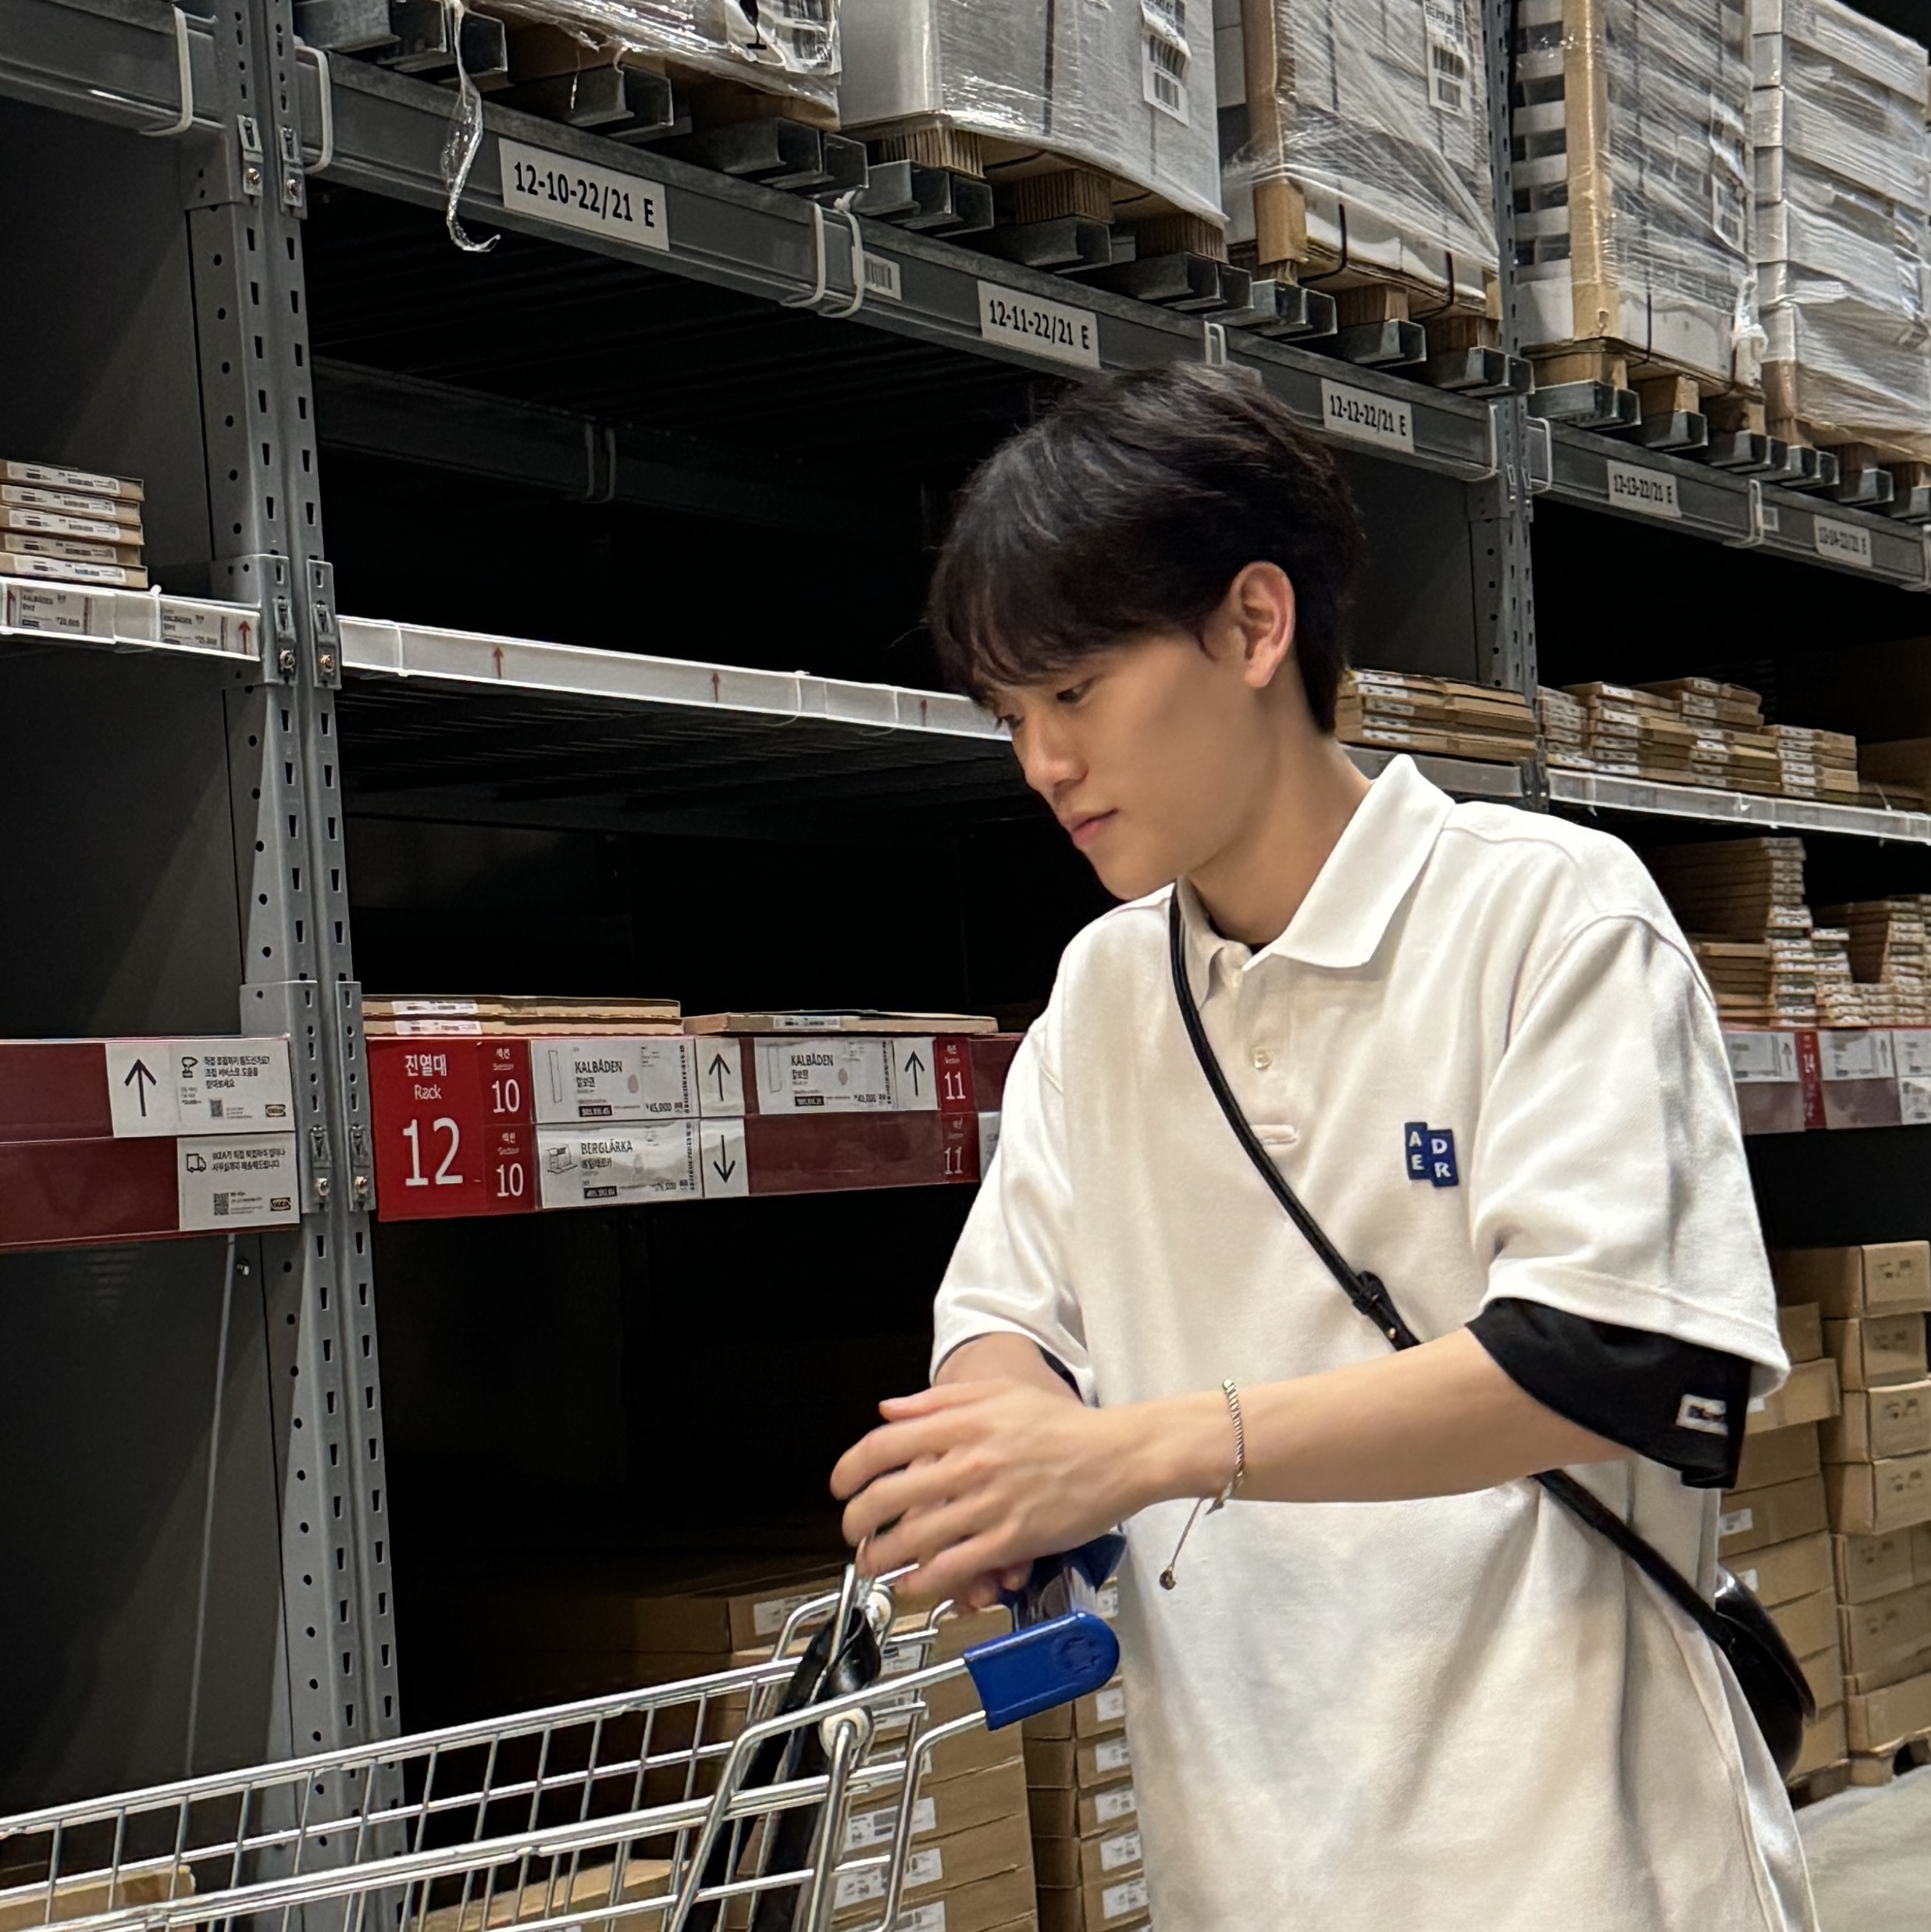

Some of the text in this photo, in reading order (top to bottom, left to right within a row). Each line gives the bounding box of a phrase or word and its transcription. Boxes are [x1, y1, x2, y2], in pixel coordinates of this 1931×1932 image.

[514, 161, 655, 227] 12-10-22/21 E
[989, 299, 1090, 349] 12-11-22/21 E
[1330, 394, 1407, 436] 12-12-22/21 E
[404, 1053, 447, 1077] 진열대
[575, 1058, 623, 1074] KALBÅDEN
[790, 1053, 834, 1067] KALBÅDEN
[414, 1084, 443, 1100] Rack
[491, 1078, 521, 1114] 10
[944, 1071, 967, 1100] 11
[402, 1117, 464, 1187] 12
[944, 1146, 964, 1175] 11
[496, 1162, 524, 1197] 10
